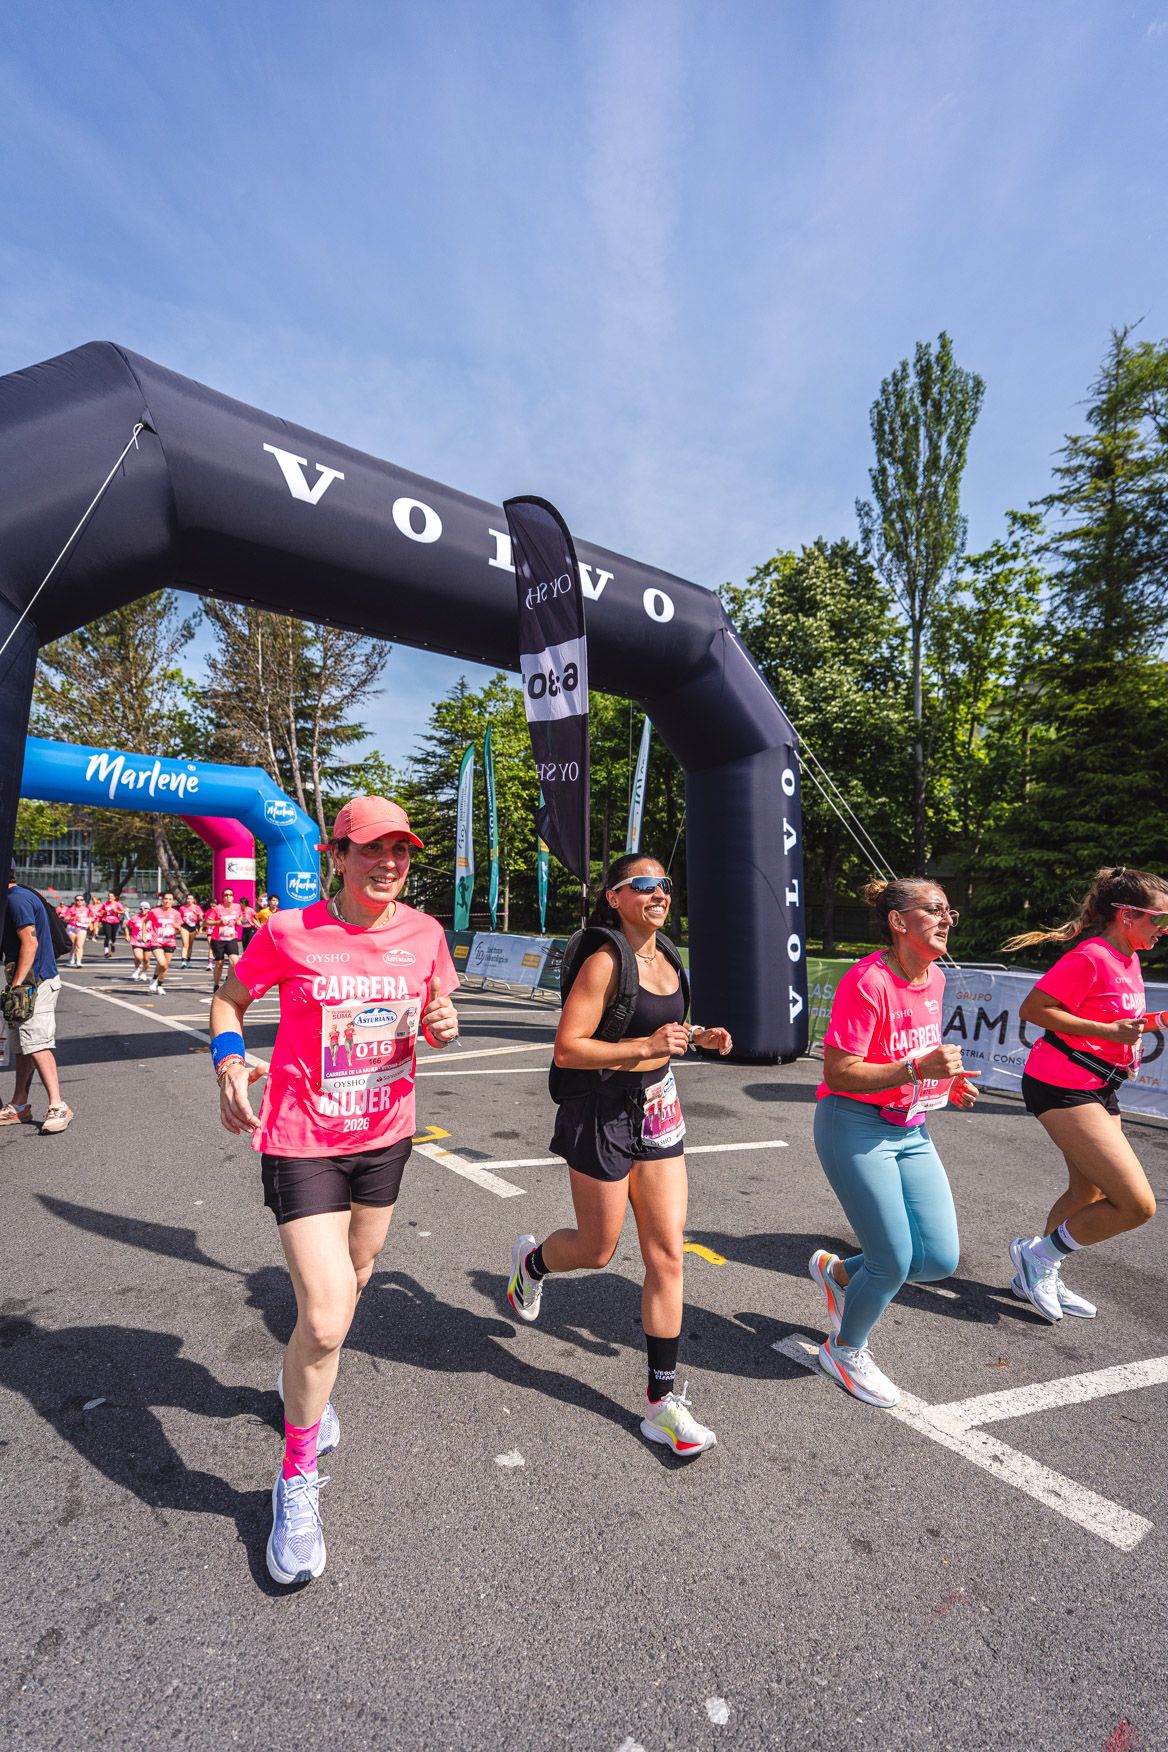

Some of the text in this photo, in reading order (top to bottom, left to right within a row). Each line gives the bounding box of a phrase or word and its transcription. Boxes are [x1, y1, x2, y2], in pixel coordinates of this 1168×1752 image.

[85, 752, 200, 800] Marlene
[781, 768, 803, 1024] VOLVO
[306, 952, 350, 964] OYSHO
[312, 975, 410, 1001] CARRERA
[955, 991, 992, 1002] GRUPO
[355, 1040, 393, 1058] 016
[325, 1070, 348, 1078] CARRERA
[333, 1078, 366, 1089] OYSHO
[318, 1086, 391, 1117] MUJER
[343, 1117, 370, 1133] 2026
